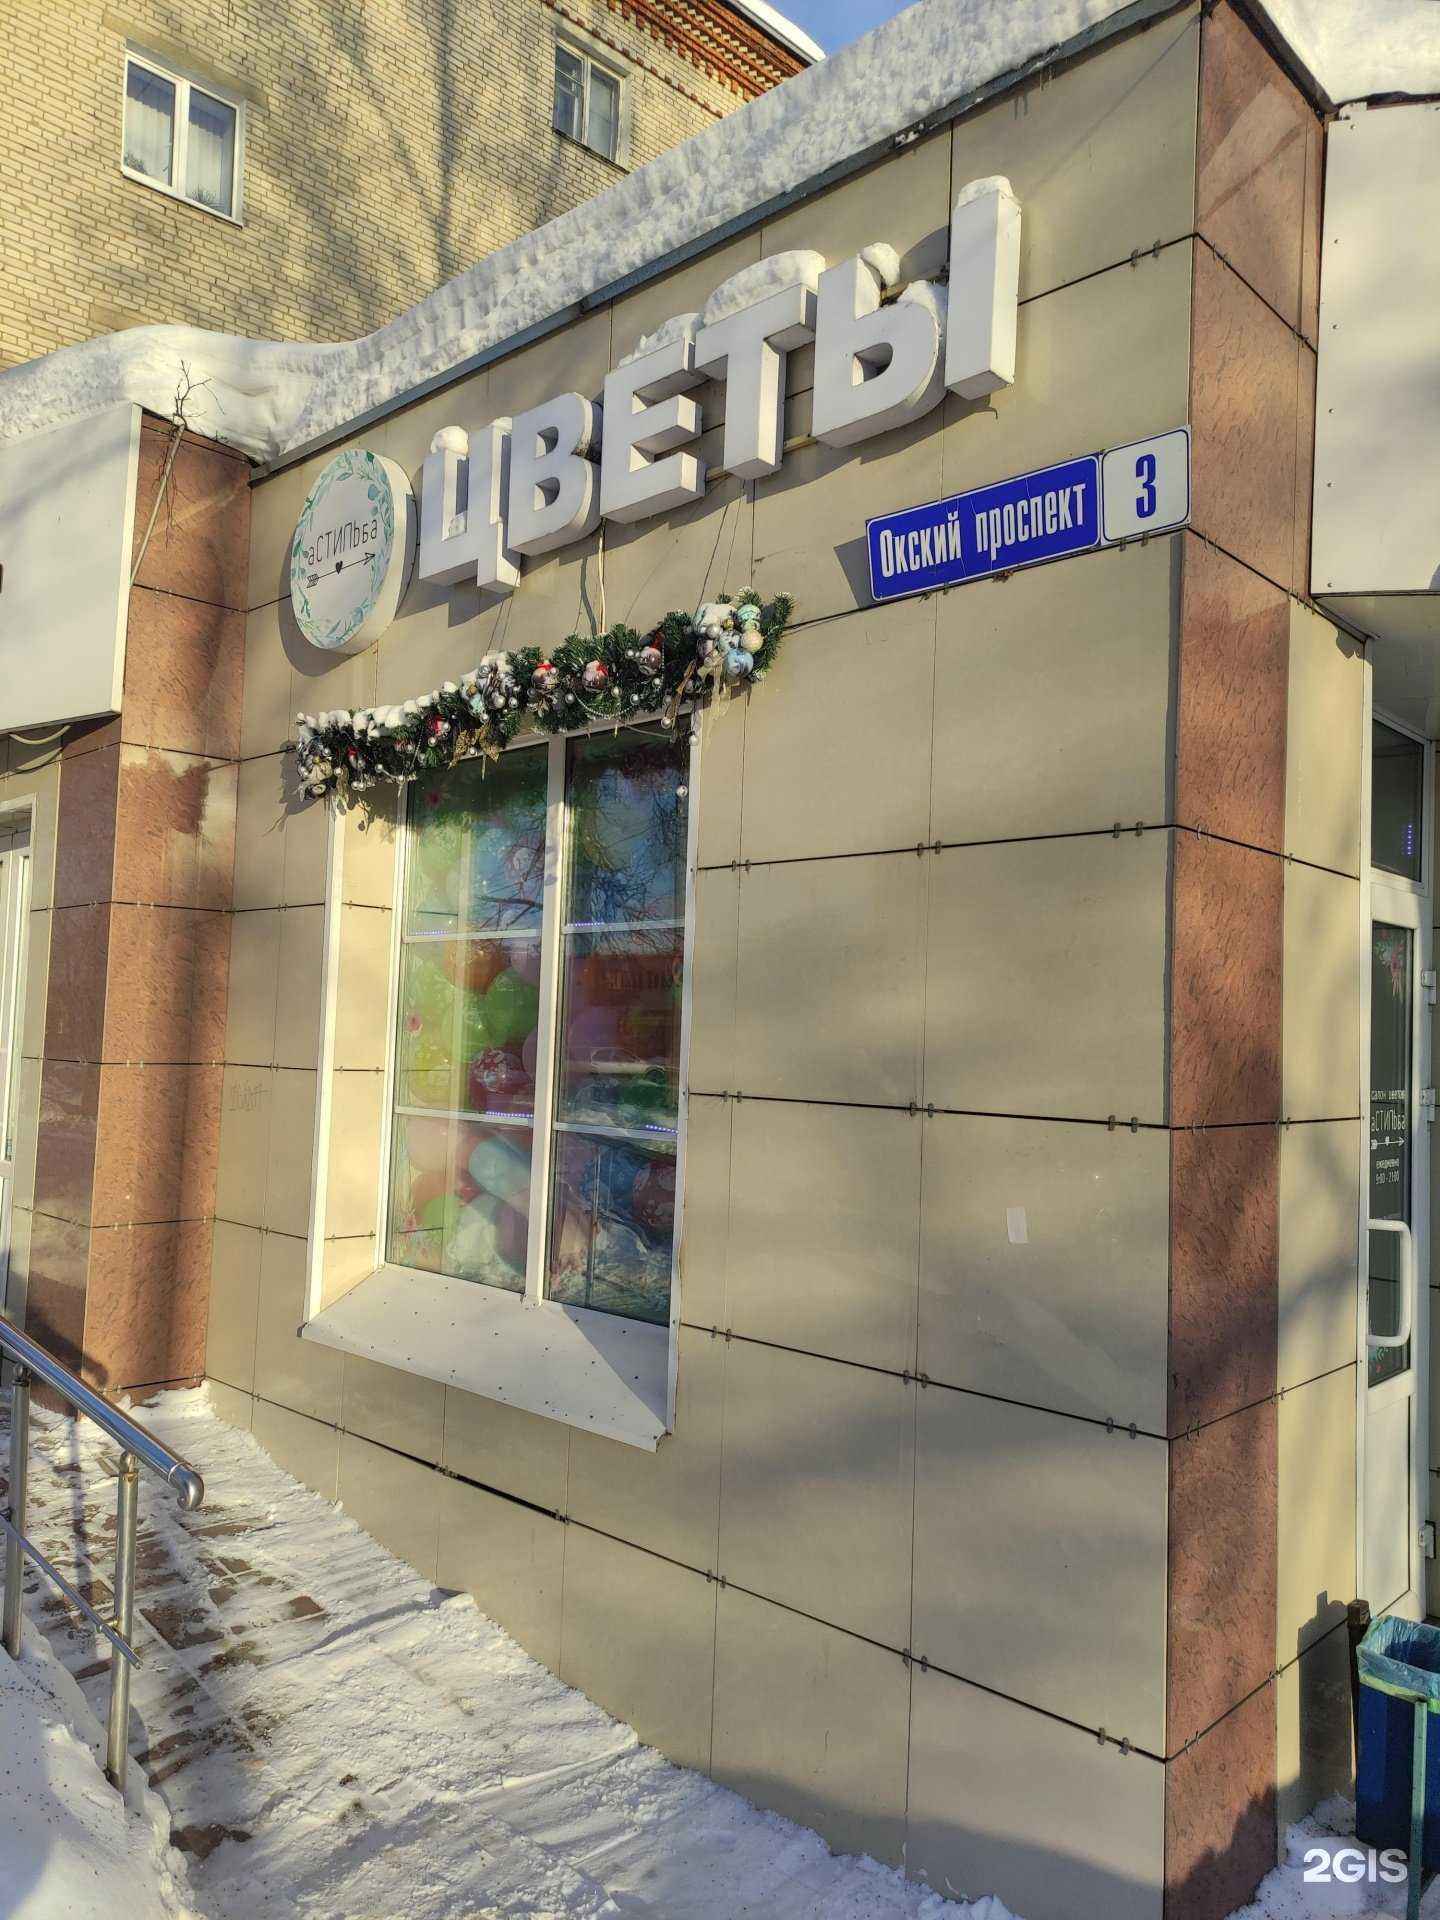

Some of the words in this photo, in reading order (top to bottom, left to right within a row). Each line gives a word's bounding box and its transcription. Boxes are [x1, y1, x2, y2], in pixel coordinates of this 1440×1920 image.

[418, 182, 1022, 593] ЦВЕТЫ
[879, 510, 962, 578] Окский
[975, 483, 1086, 561] проспект
[1134, 453, 1157, 519] 3
